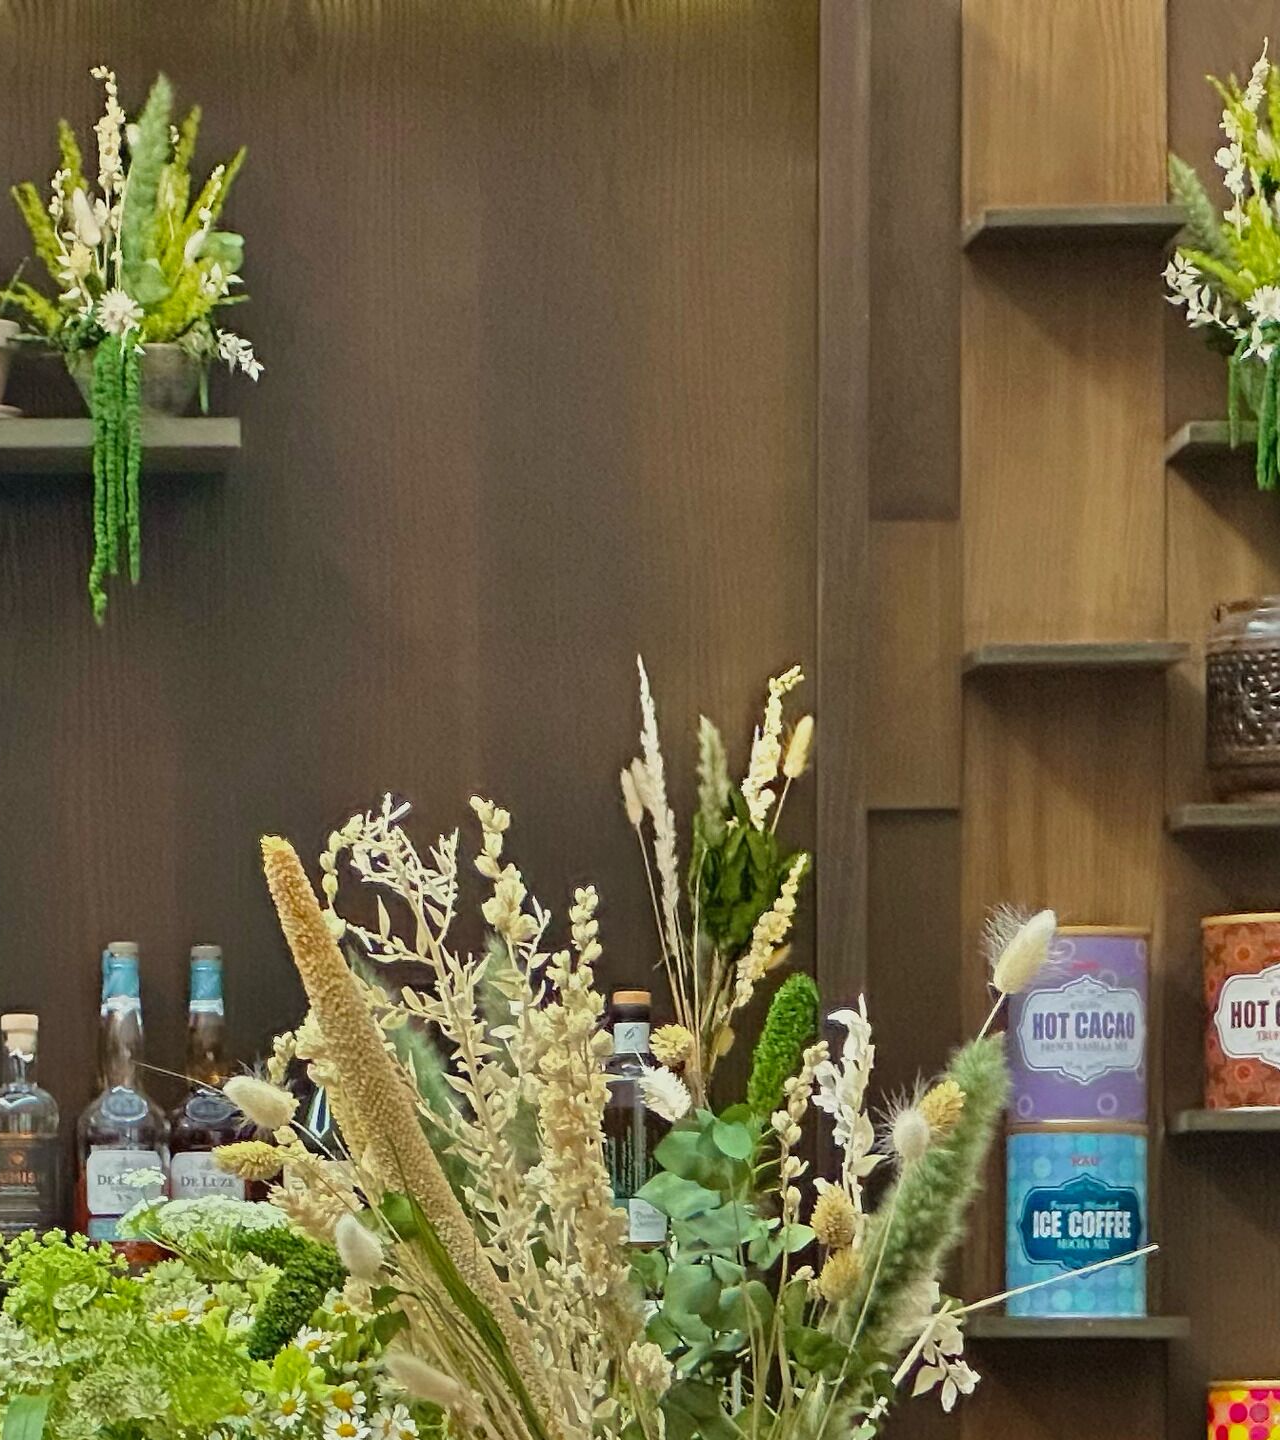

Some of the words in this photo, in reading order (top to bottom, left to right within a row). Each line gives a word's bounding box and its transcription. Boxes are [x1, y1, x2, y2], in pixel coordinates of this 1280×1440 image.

[1032, 1011, 1070, 1041] HOT
[1074, 1011, 1136, 1040] CACAO
[1230, 999, 1270, 1029] HOT
[180, 1175, 199, 1188] DE
[202, 1175, 236, 1188] LUZE
[1032, 1210, 1062, 1239] ICE
[1068, 1210, 1132, 1239] COFFEE
